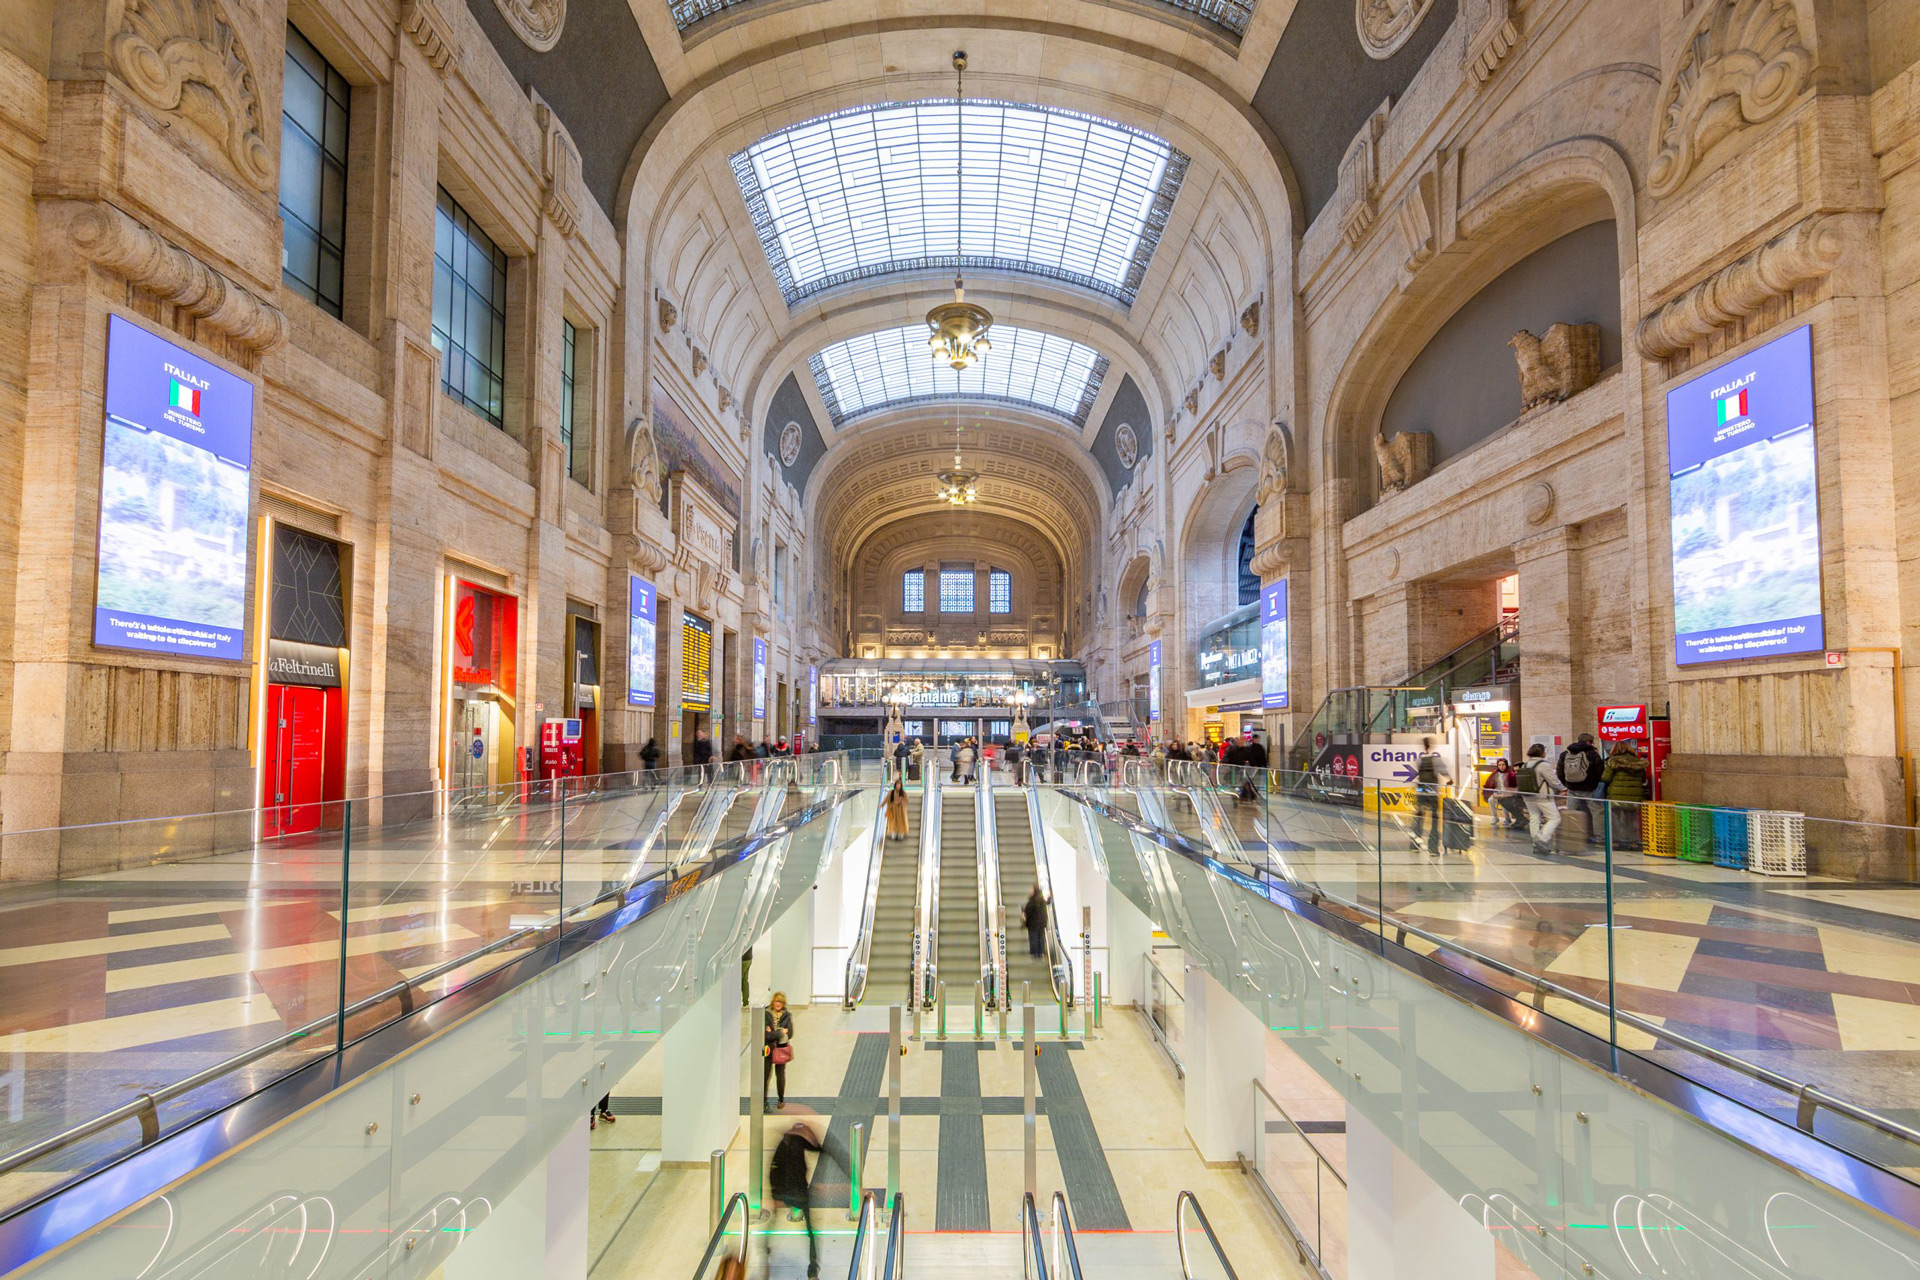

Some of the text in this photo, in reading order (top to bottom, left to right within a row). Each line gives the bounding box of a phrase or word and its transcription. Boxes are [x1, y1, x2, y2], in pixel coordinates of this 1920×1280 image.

[164, 362, 210, 390] ITALIA.IT
[1710, 371, 1756, 400] ITALIA.IT
[163, 412, 177, 423] DEL
[168, 409, 202, 427] MINISTERO
[1717, 418, 1751, 436] MINISTERO
[1713, 434, 1727, 443] DEL
[1787, 625, 1805, 634] Italy
[216, 633, 232, 643] Italy
[1462, 690, 1491, 702] change
